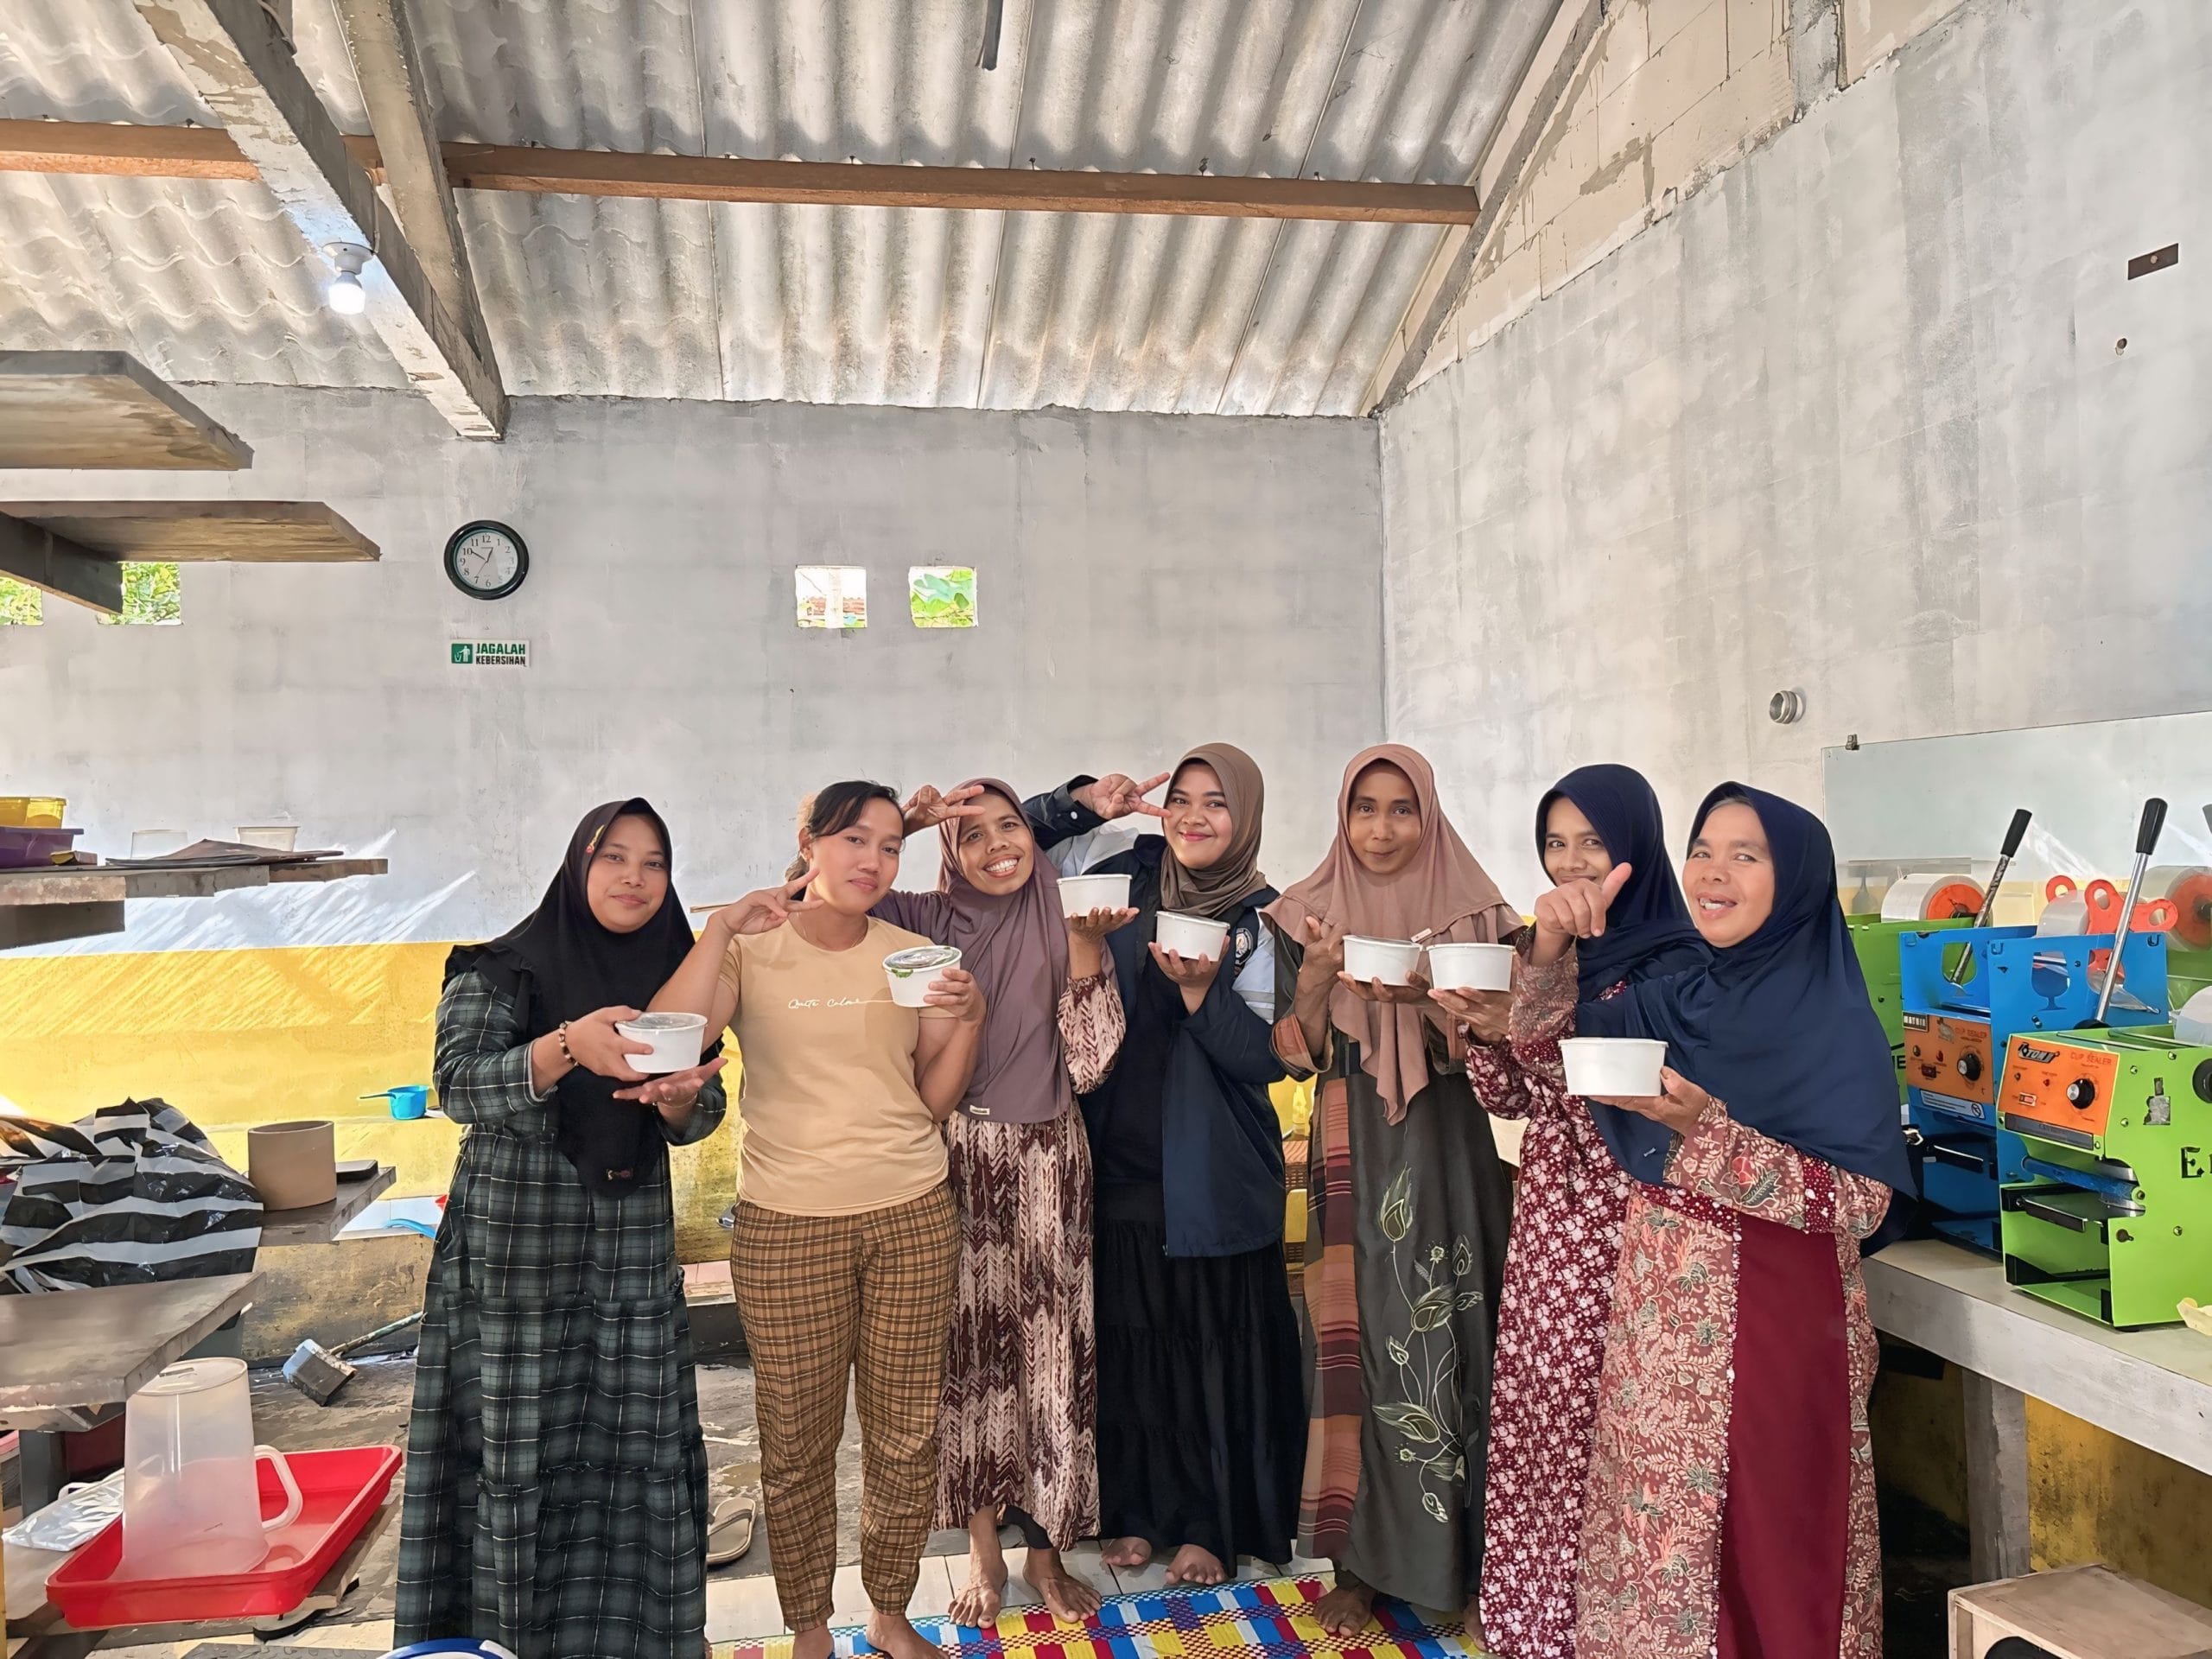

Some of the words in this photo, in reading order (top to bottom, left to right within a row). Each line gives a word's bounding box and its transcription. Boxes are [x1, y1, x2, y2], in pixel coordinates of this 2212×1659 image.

[471, 537, 479, 547] 11
[481, 535, 492, 543] 12
[462, 547, 473, 556] 10
[505, 545, 511, 554] 2
[459, 557, 466, 566] 9
[474, 575, 480, 584] 7
[485, 579, 492, 588] 6
[475, 643, 526, 655] JAGALAH
[475, 655, 526, 665] KEBERSIHAN
